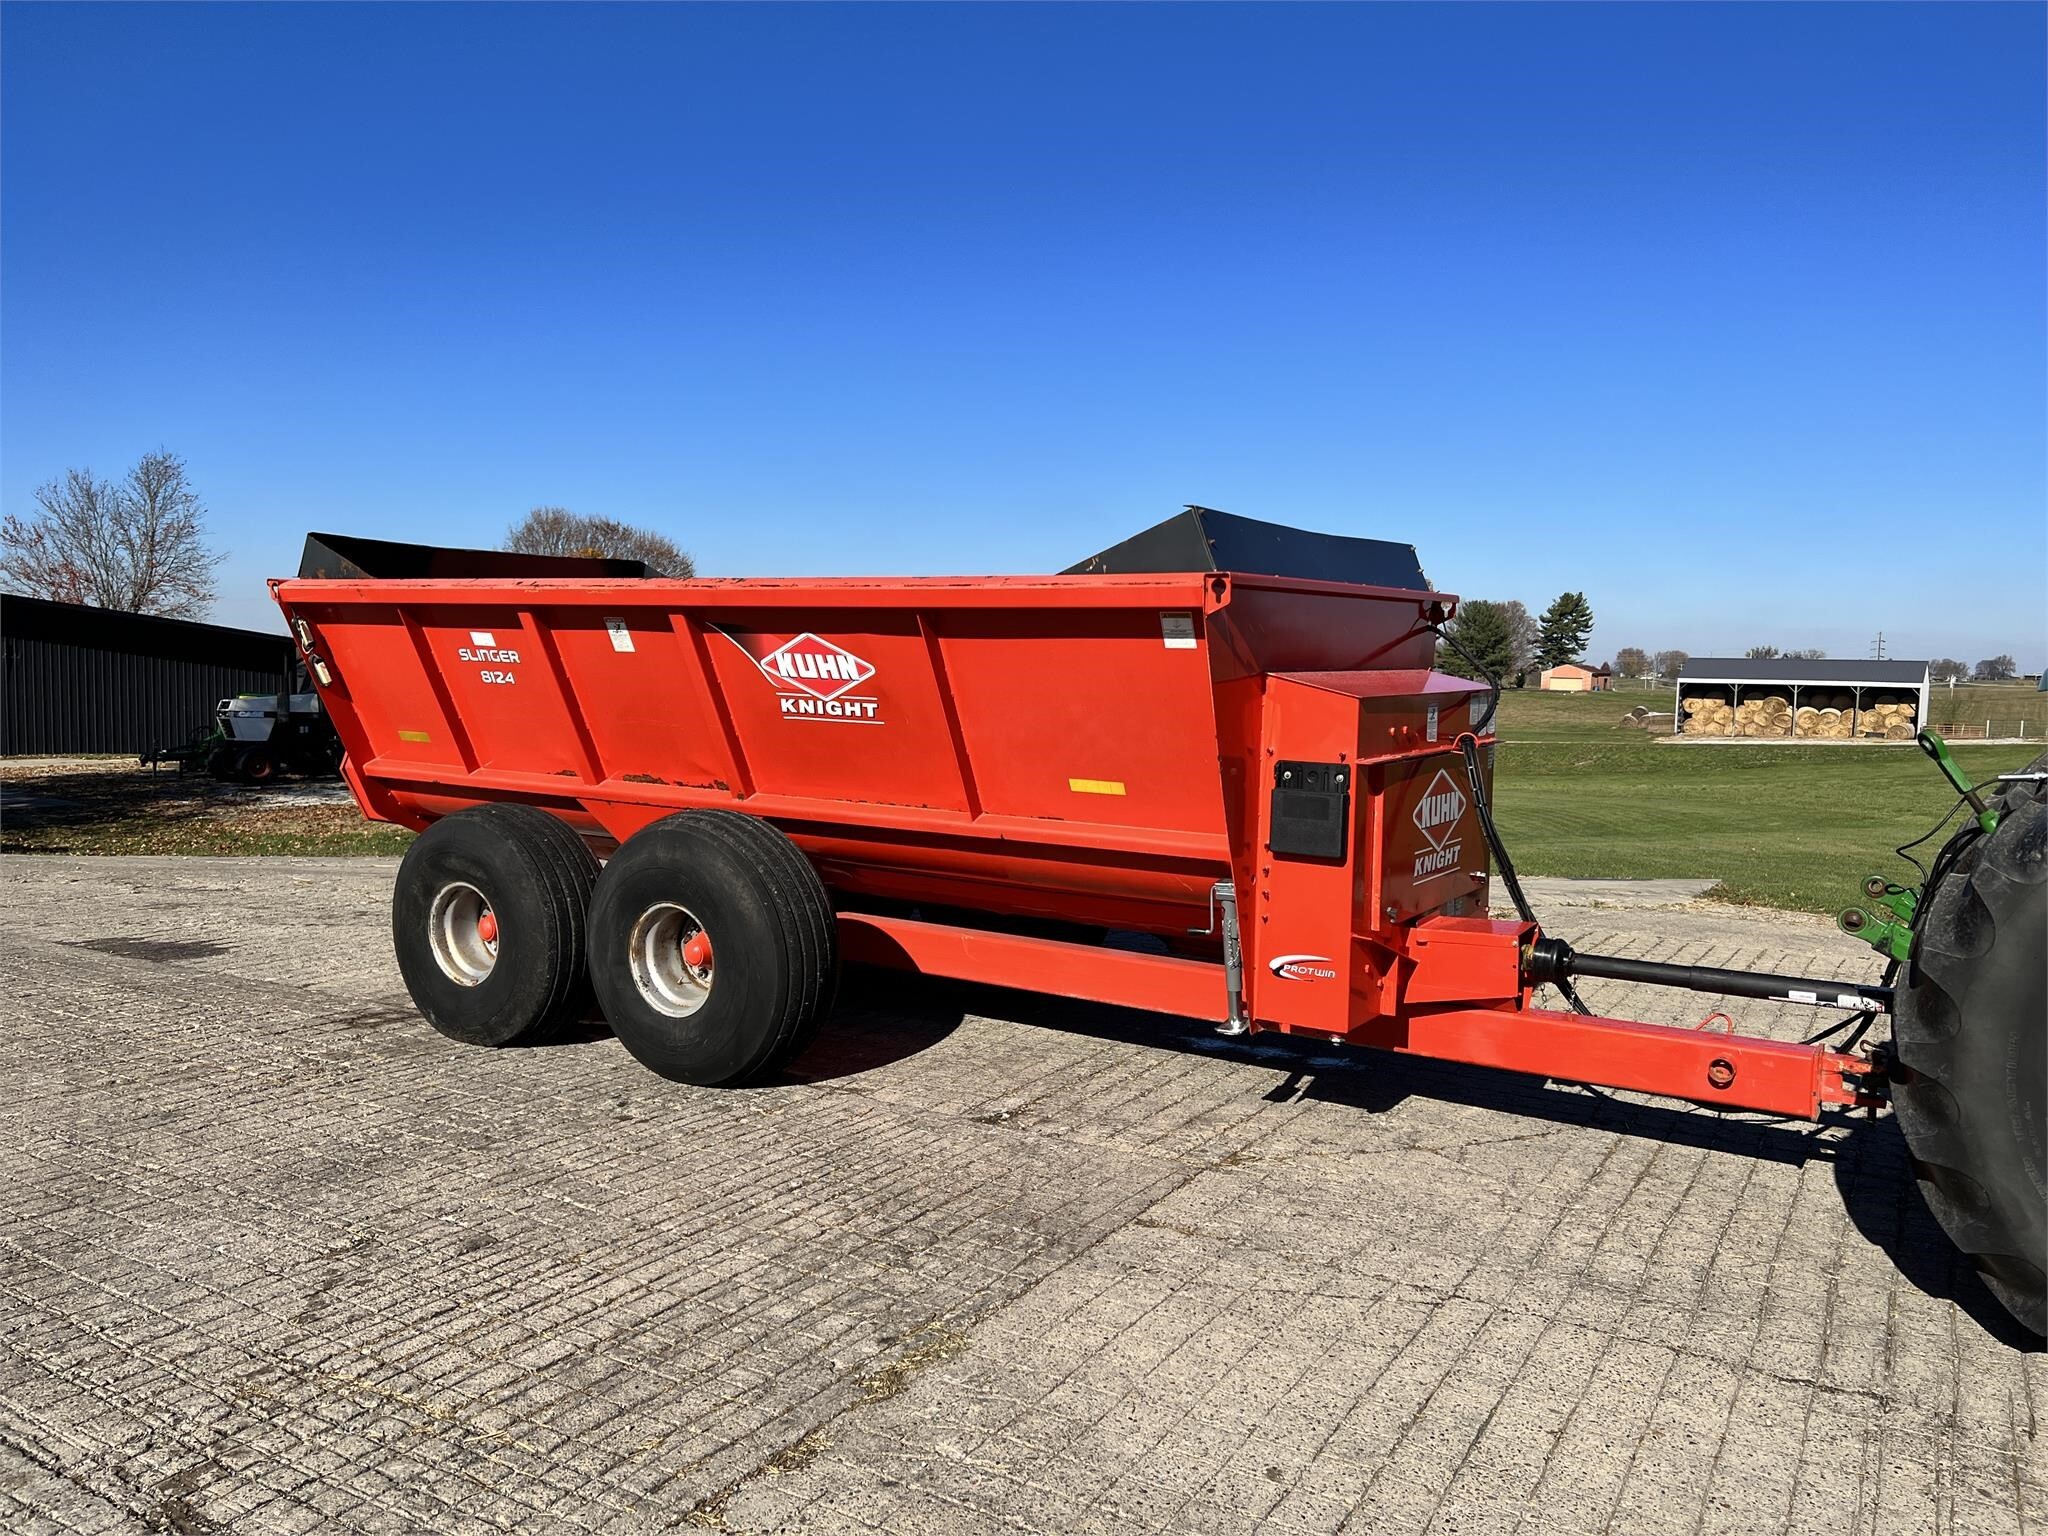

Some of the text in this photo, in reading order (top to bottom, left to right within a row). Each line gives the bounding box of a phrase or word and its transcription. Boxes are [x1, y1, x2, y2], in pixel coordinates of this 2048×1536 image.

[458, 648, 520, 664] SLINGER
[774, 652, 860, 681] KUHN
[480, 670, 515, 685] 8124
[780, 698, 878, 718] KNIGHT
[1420, 791, 1460, 829] KUHN
[1413, 844, 1461, 878] KNIGHT
[1283, 964, 1336, 978] PROTWIN
